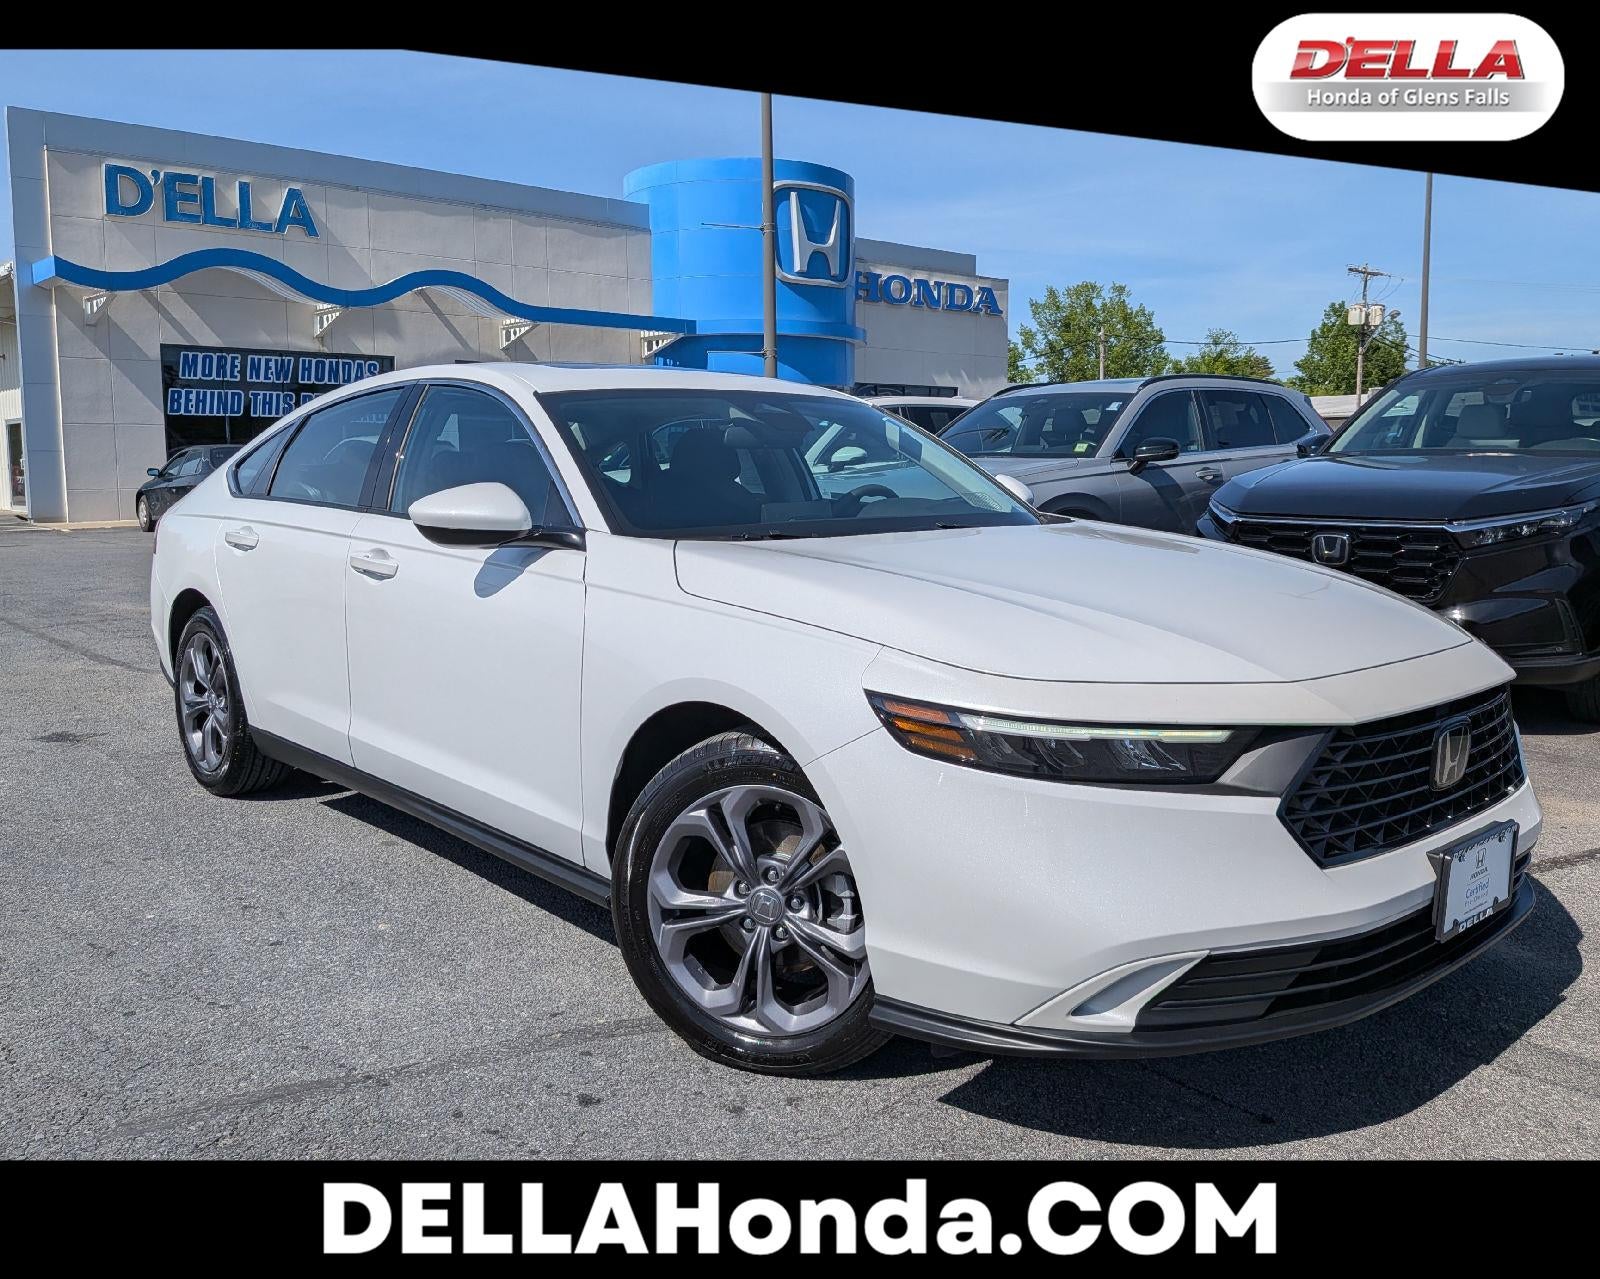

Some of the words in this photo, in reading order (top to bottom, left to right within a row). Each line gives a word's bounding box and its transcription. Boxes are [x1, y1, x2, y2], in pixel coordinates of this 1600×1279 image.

[103, 162, 320, 239] D'ELLA
[855, 270, 1004, 316] HONDA
[179, 351, 242, 382] MORE
[246, 354, 294, 384] NEW
[298, 357, 380, 385] HONDAS
[167, 387, 244, 417] BEHIND
[250, 389, 296, 418] THIS
